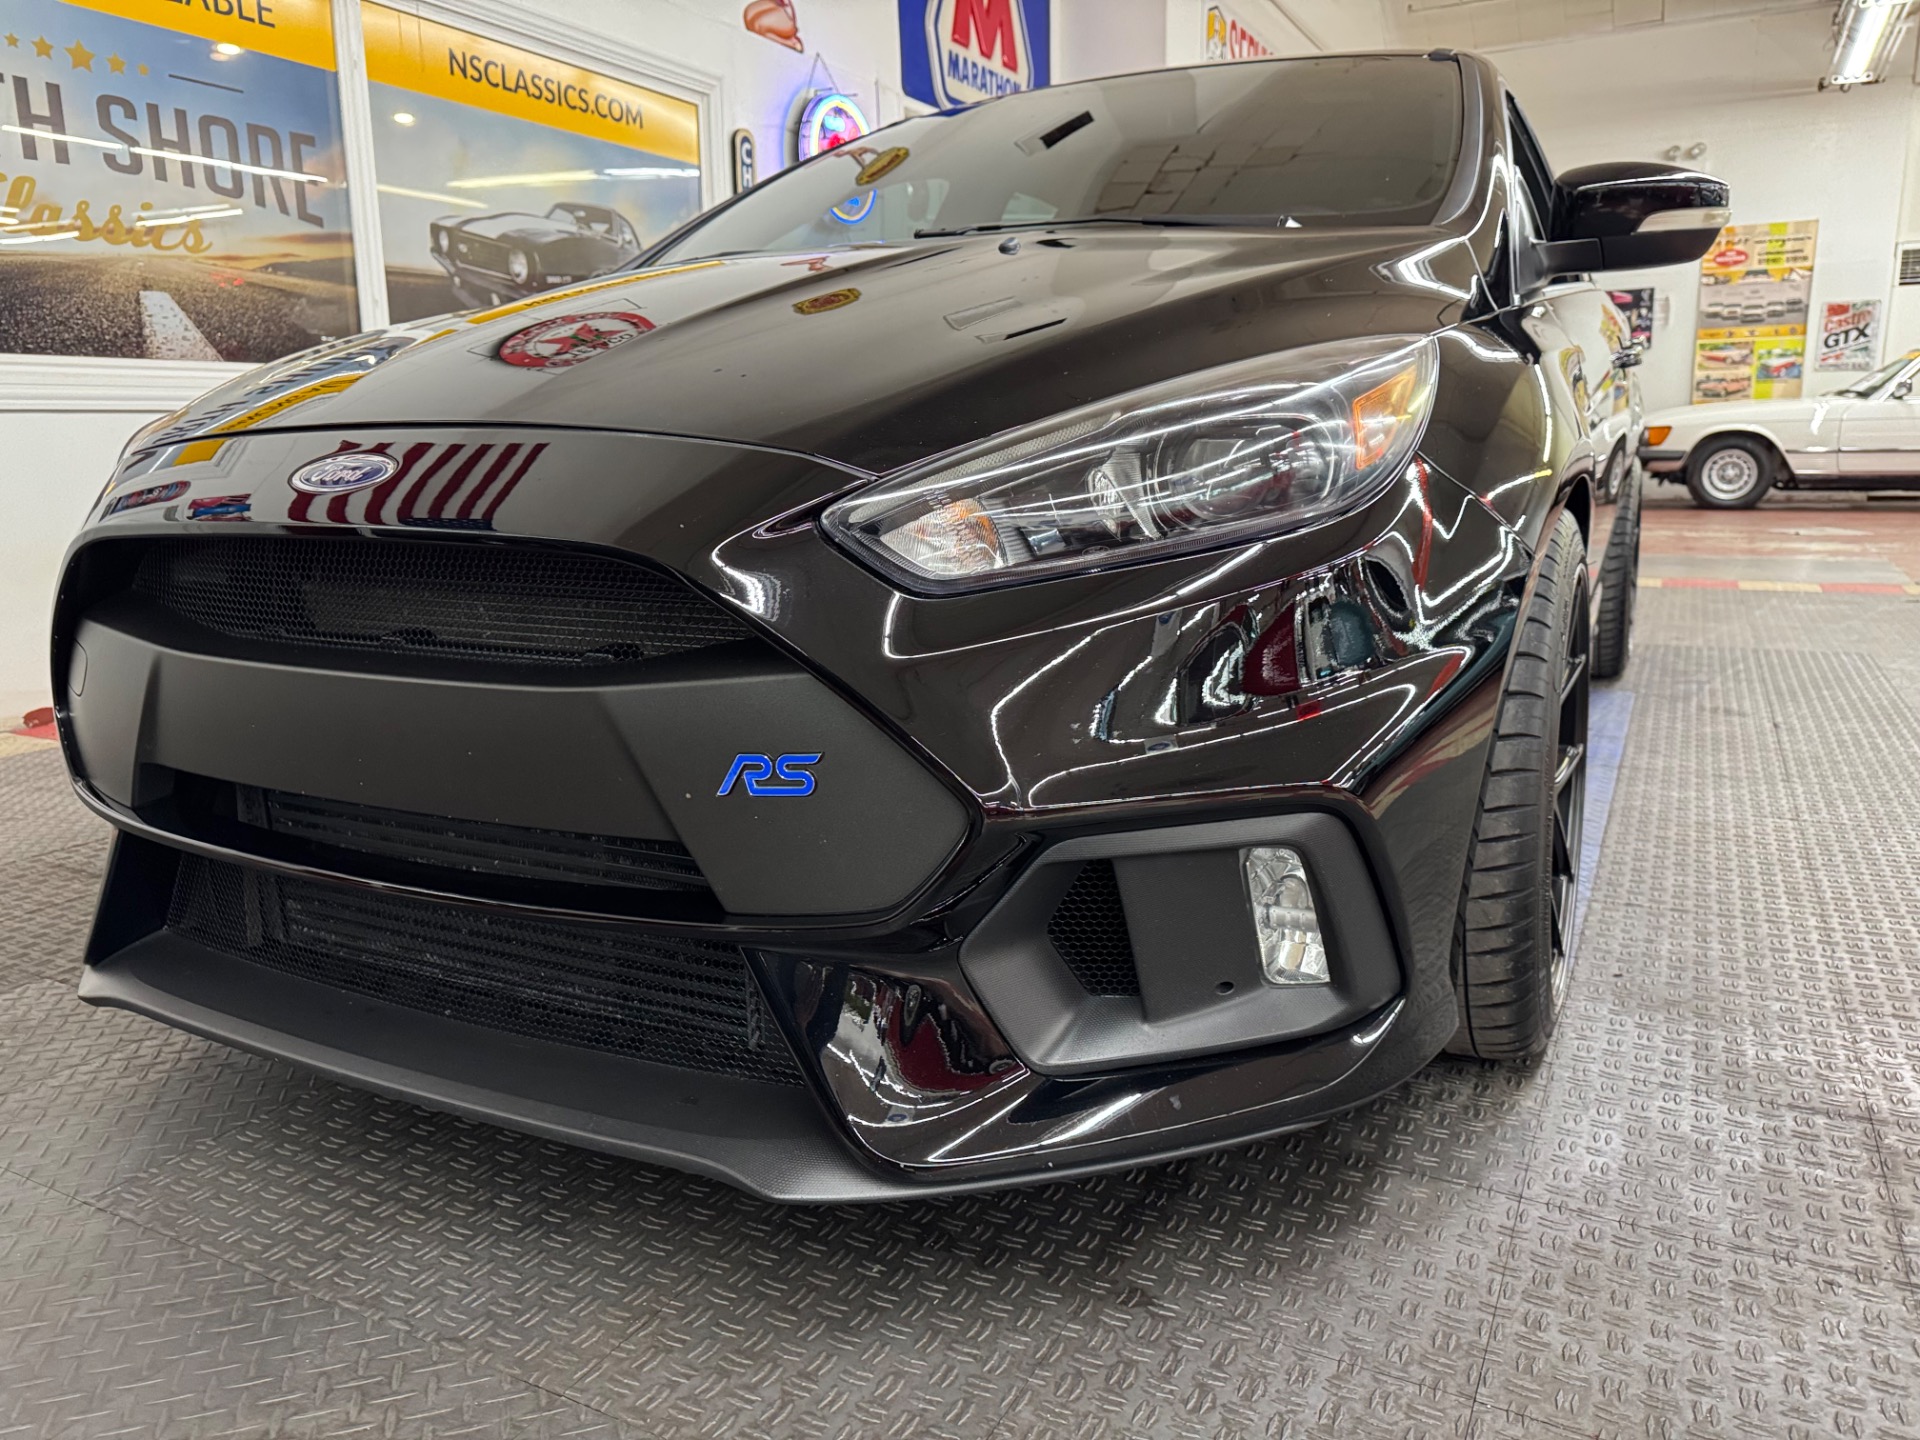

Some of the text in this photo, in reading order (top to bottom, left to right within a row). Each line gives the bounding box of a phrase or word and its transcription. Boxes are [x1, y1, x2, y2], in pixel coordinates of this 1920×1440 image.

[951, 0, 1018, 73] M
[448, 47, 644, 129] NSCLASSICS.COM
[0, 72, 324, 228] H SHORE
[0, 173, 213, 254] lassics
[1824, 322, 1869, 349] GTX
[311, 462, 372, 482] Ford
[717, 753, 822, 797] RS
